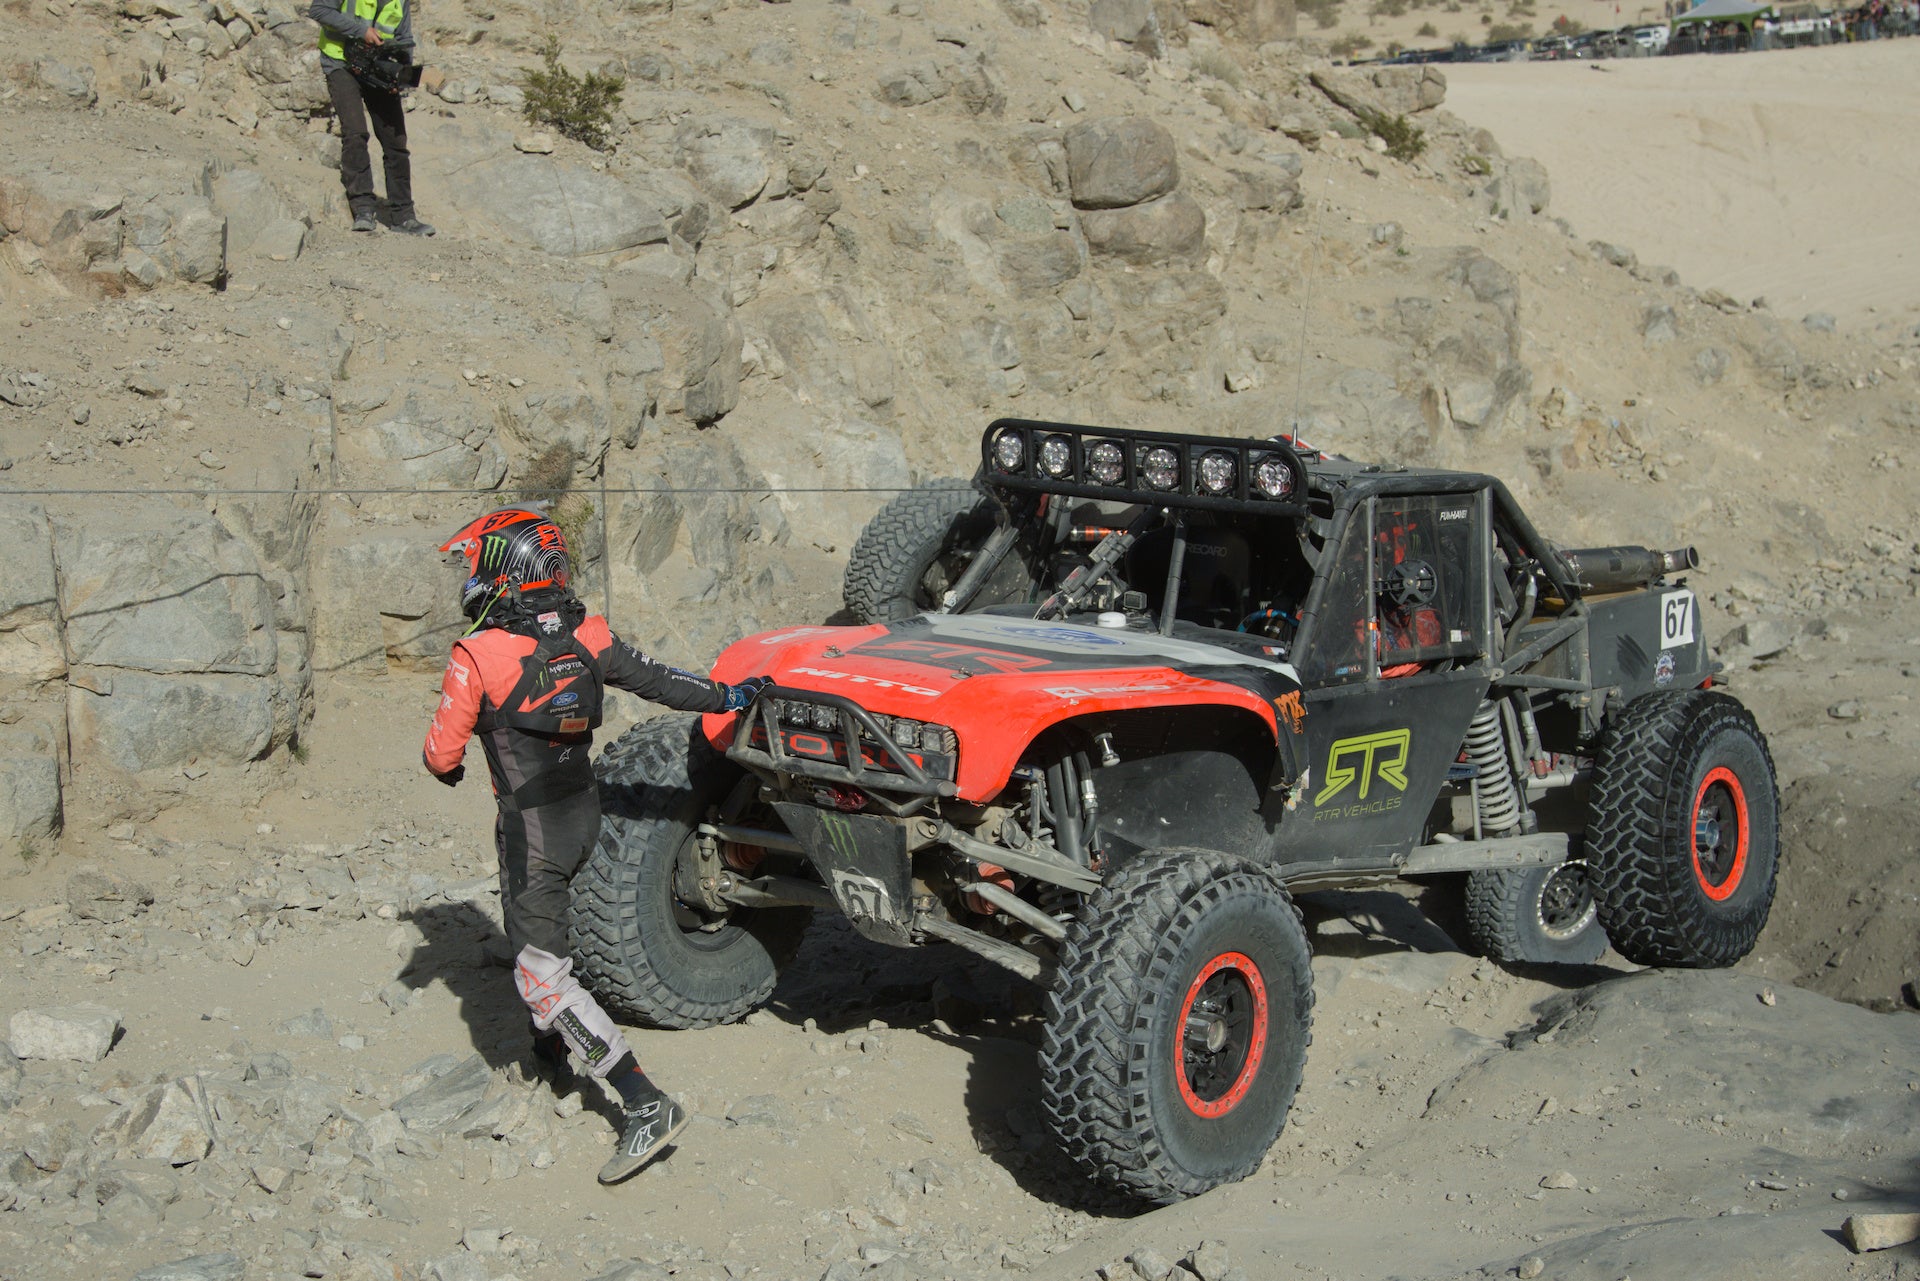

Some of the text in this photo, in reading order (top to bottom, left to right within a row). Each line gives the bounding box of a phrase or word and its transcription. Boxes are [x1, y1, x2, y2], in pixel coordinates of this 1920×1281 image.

[482, 512, 519, 531] 67
[1665, 597, 1690, 639] 67
[549, 660, 584, 674] MONSTER
[671, 674, 711, 690] RACING
[789, 667, 942, 697] NITTO
[1313, 796, 1402, 822] RTR VEHICLES
[841, 879, 882, 929] 67
